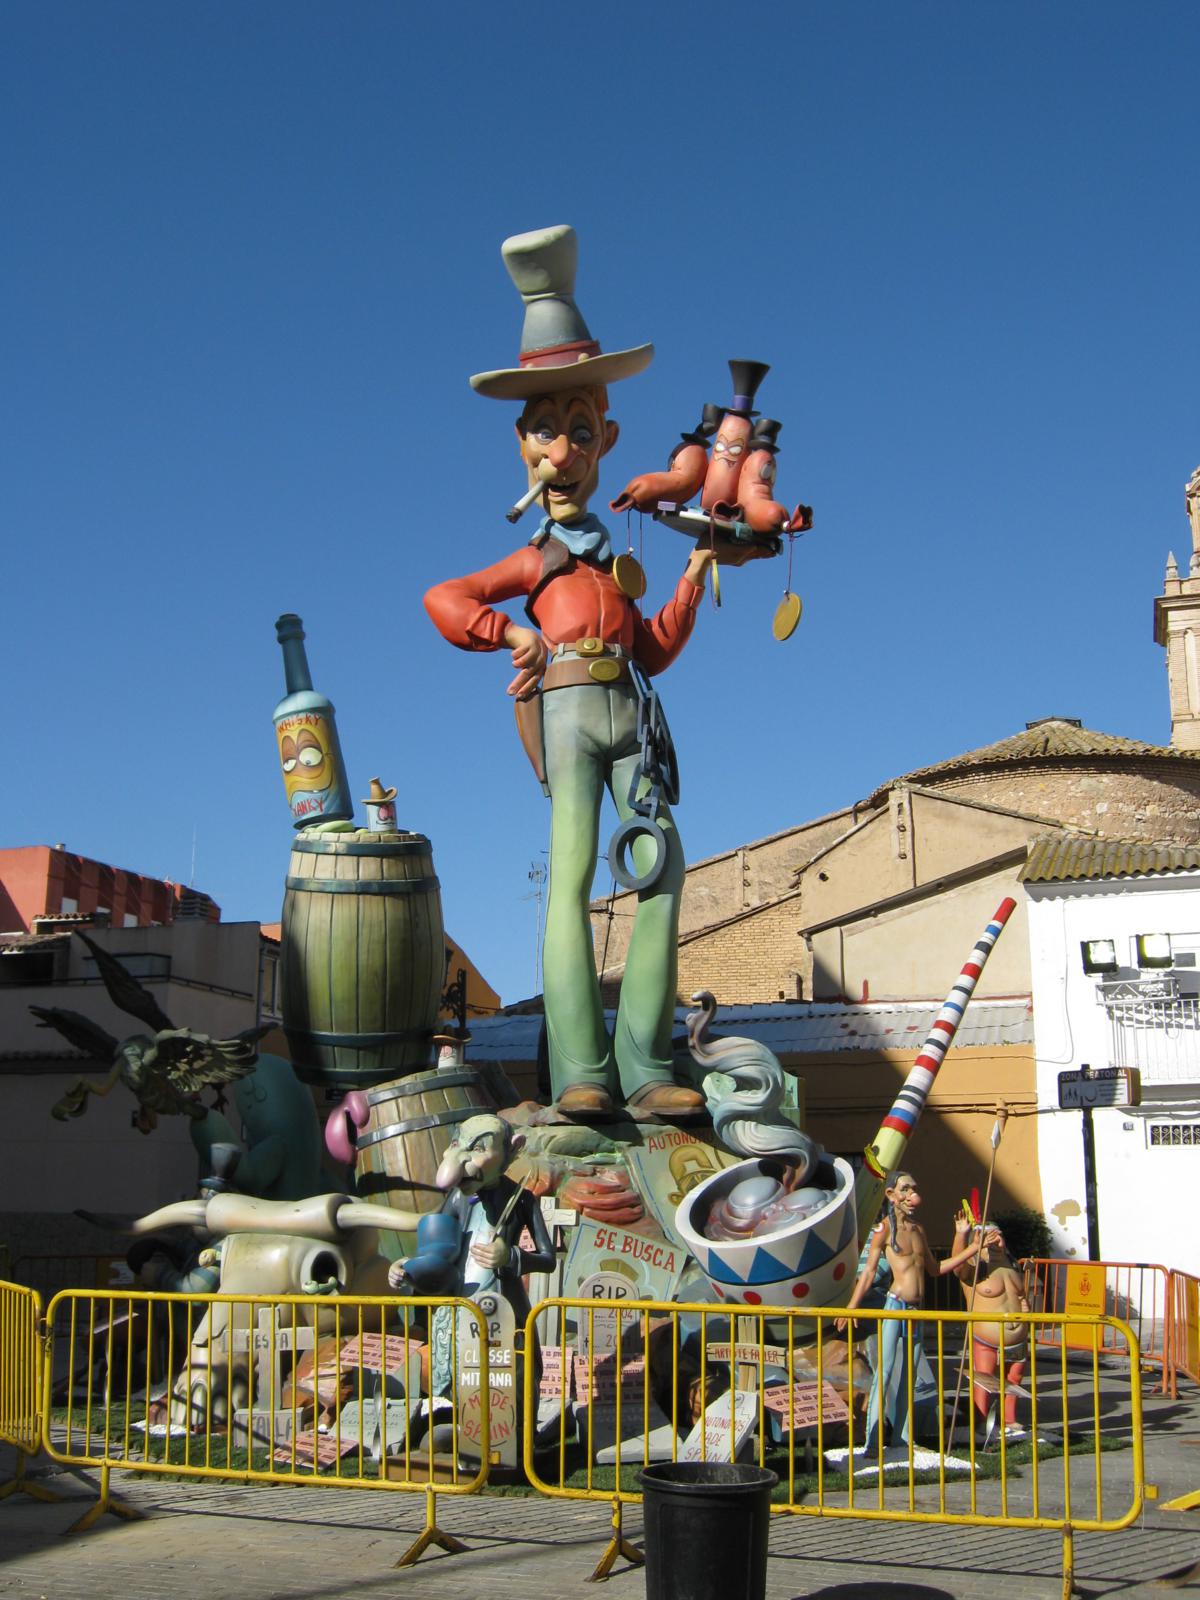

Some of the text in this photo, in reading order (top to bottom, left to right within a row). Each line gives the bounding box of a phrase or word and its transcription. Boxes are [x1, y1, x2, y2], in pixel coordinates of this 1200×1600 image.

[1085, 1068, 1127, 1079] PEATONAL
[594, 1227, 676, 1273] SE BUSCA
[464, 1348, 511, 1364] CLSSE
[461, 1372, 513, 1387] MITANA
[468, 1392, 510, 1410] MDE
[463, 1420, 511, 1440] SPIN
